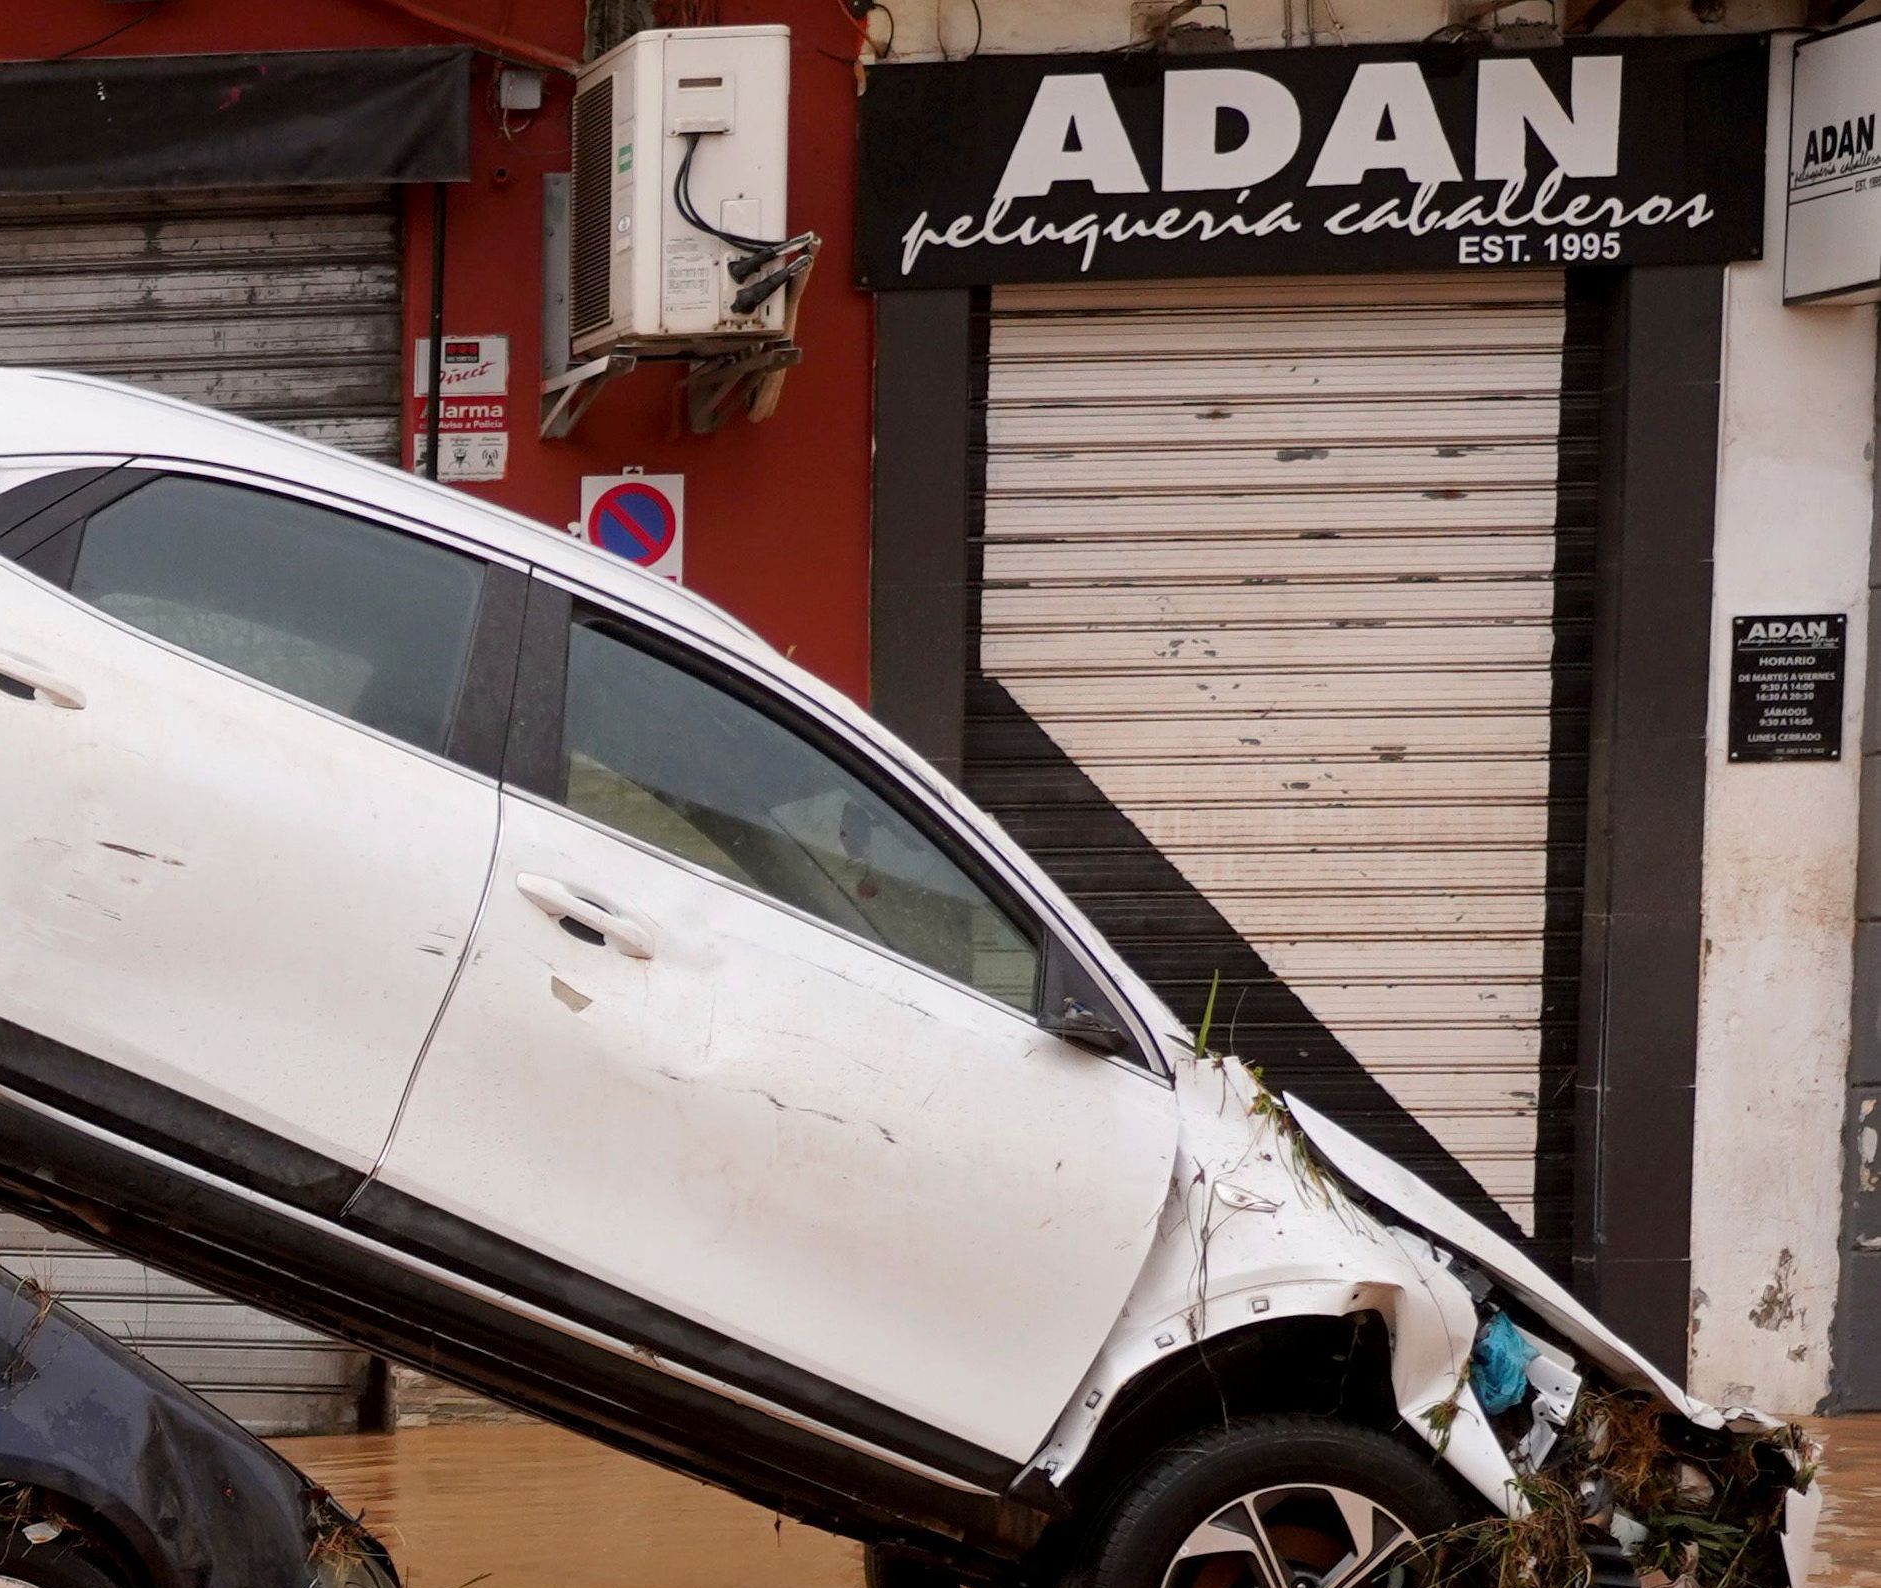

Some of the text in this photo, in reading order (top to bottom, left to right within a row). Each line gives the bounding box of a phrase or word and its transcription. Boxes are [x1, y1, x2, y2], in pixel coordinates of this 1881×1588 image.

[993, 55, 1623, 198] ADAN
[1803, 113, 1875, 168] ADAN
[901, 170, 1715, 275] peluquería caballeros
[1458, 232, 1621, 264] EST. 1995
[1747, 621, 1827, 639] ADAN
[1759, 656, 1816, 666] HORARIO
[1738, 674, 1750, 682] DE
[1752, 673, 1789, 682] MARTES
[1798, 672, 1836, 681] VIERNES
[1760, 683, 1780, 691] 9:30
[1789, 692, 1814, 700] 20:30
[1759, 718, 1778, 726] 9:30
[1747, 733, 1821, 742] LUNES CERRADO
